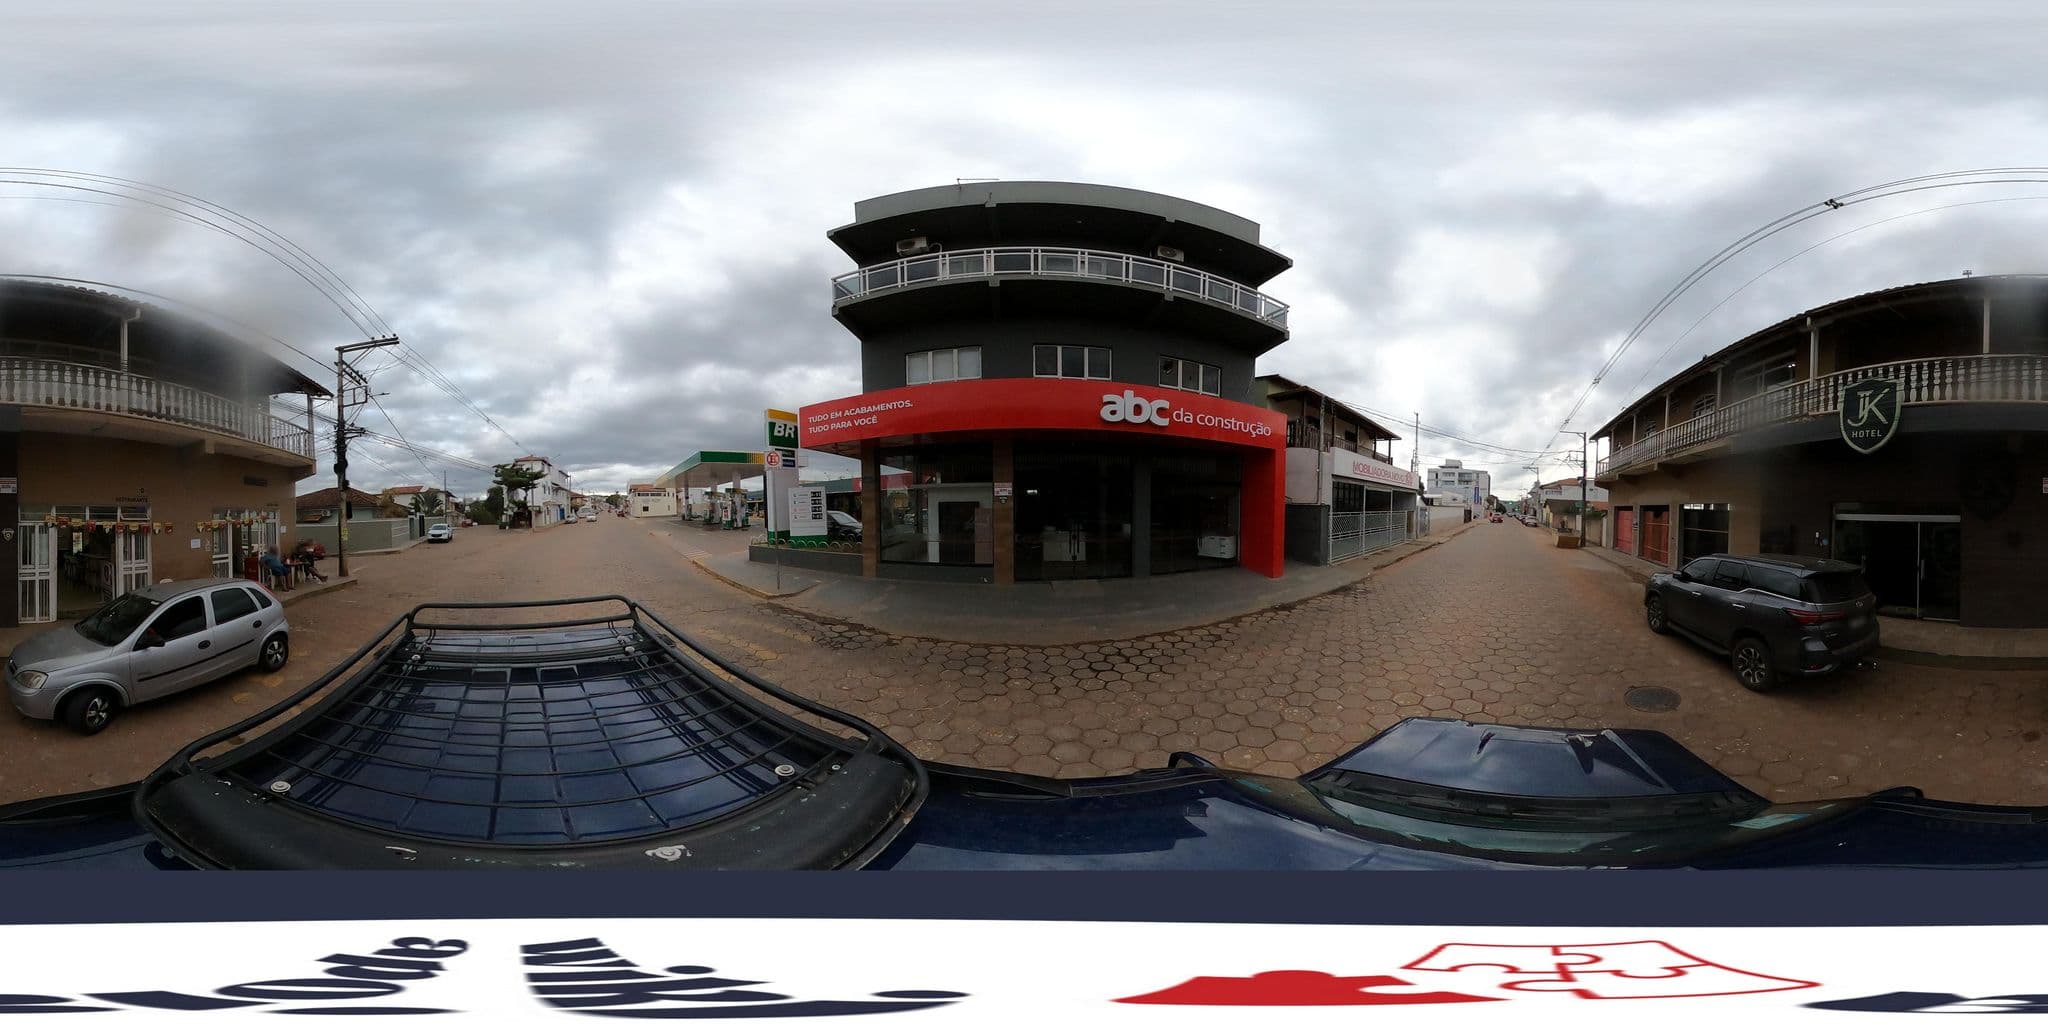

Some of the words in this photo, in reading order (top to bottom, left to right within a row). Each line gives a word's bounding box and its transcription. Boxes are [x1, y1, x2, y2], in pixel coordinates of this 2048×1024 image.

[808, 414, 829, 424] TUDO
[830, 410, 842, 419] EM
[844, 400, 913, 417] ACABAMENTOS.
[1099, 389, 1170, 426] abc
[1172, 408, 1193, 424] da
[1197, 413, 1272, 437] construção
[774, 422, 796, 439] BR
[808, 425, 829, 434] TUDO
[831, 421, 852, 431] PARA
[854, 415, 878, 427] VOCÊ
[1851, 429, 1883, 438] HOTEL
